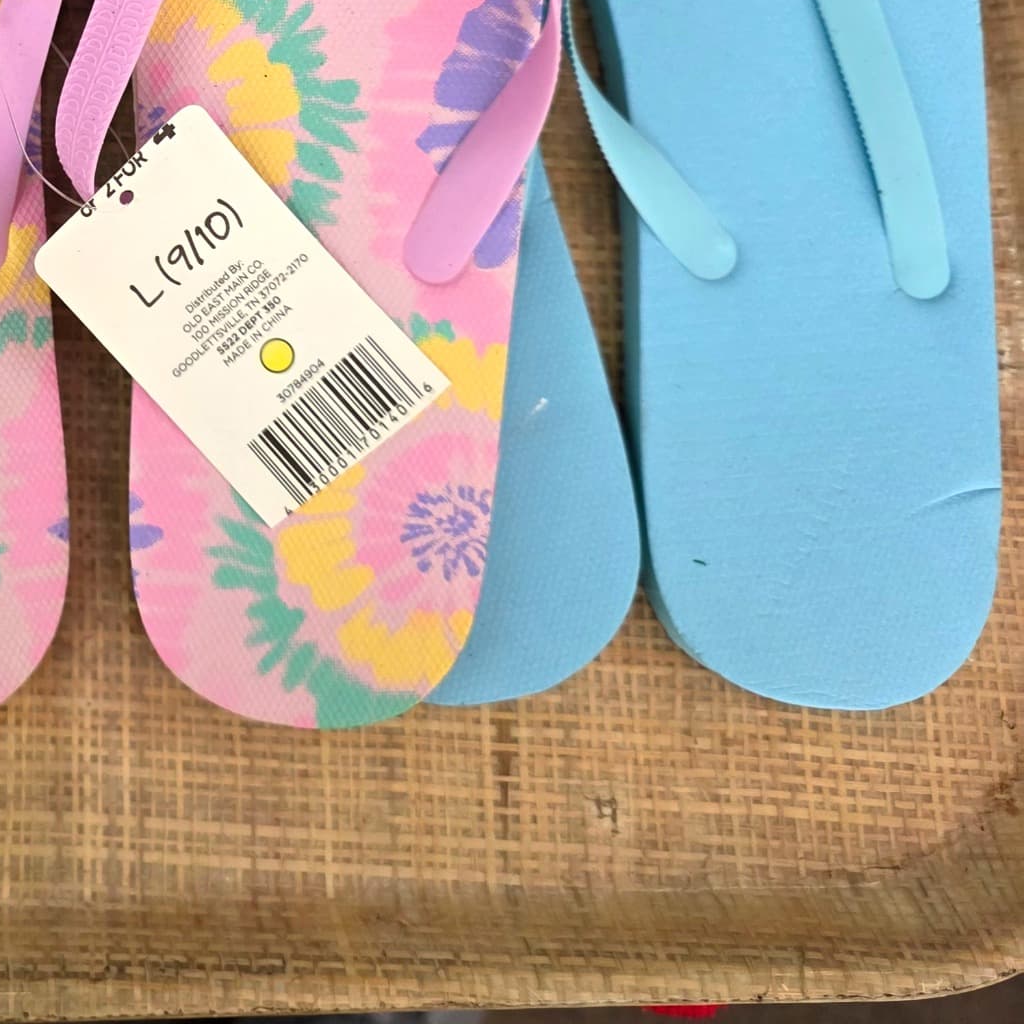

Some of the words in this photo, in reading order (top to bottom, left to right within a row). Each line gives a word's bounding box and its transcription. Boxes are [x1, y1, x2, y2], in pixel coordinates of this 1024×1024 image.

[113, 151, 148, 187] FOR
[129, 285, 164, 307] L
[155, 198, 243, 285] (9/10)
[172, 309, 248, 377] GOODLETTSVILLE,
[245, 297, 260, 310] TN
[258, 253, 309, 300] 37072-2170
[182, 314, 202, 333] OLD
[201, 293, 225, 317] EAST
[223, 272, 249, 296] MAIN
[247, 260, 264, 274] CO.
[185, 271, 230, 314] Distributed
[228, 260, 245, 275] By:
[191, 325, 210, 342] 100
[208, 292, 245, 327] MISSION
[243, 269, 272, 296] RIDGE
[238, 311, 263, 336] DEPT
[262, 296, 281, 314] 350
[223, 339, 252, 367] MADE
[250, 330, 263, 343] IN
[261, 304, 293, 332] CHINA
[276, 358, 325, 404] 30784904
[423, 381, 433, 393] 6
